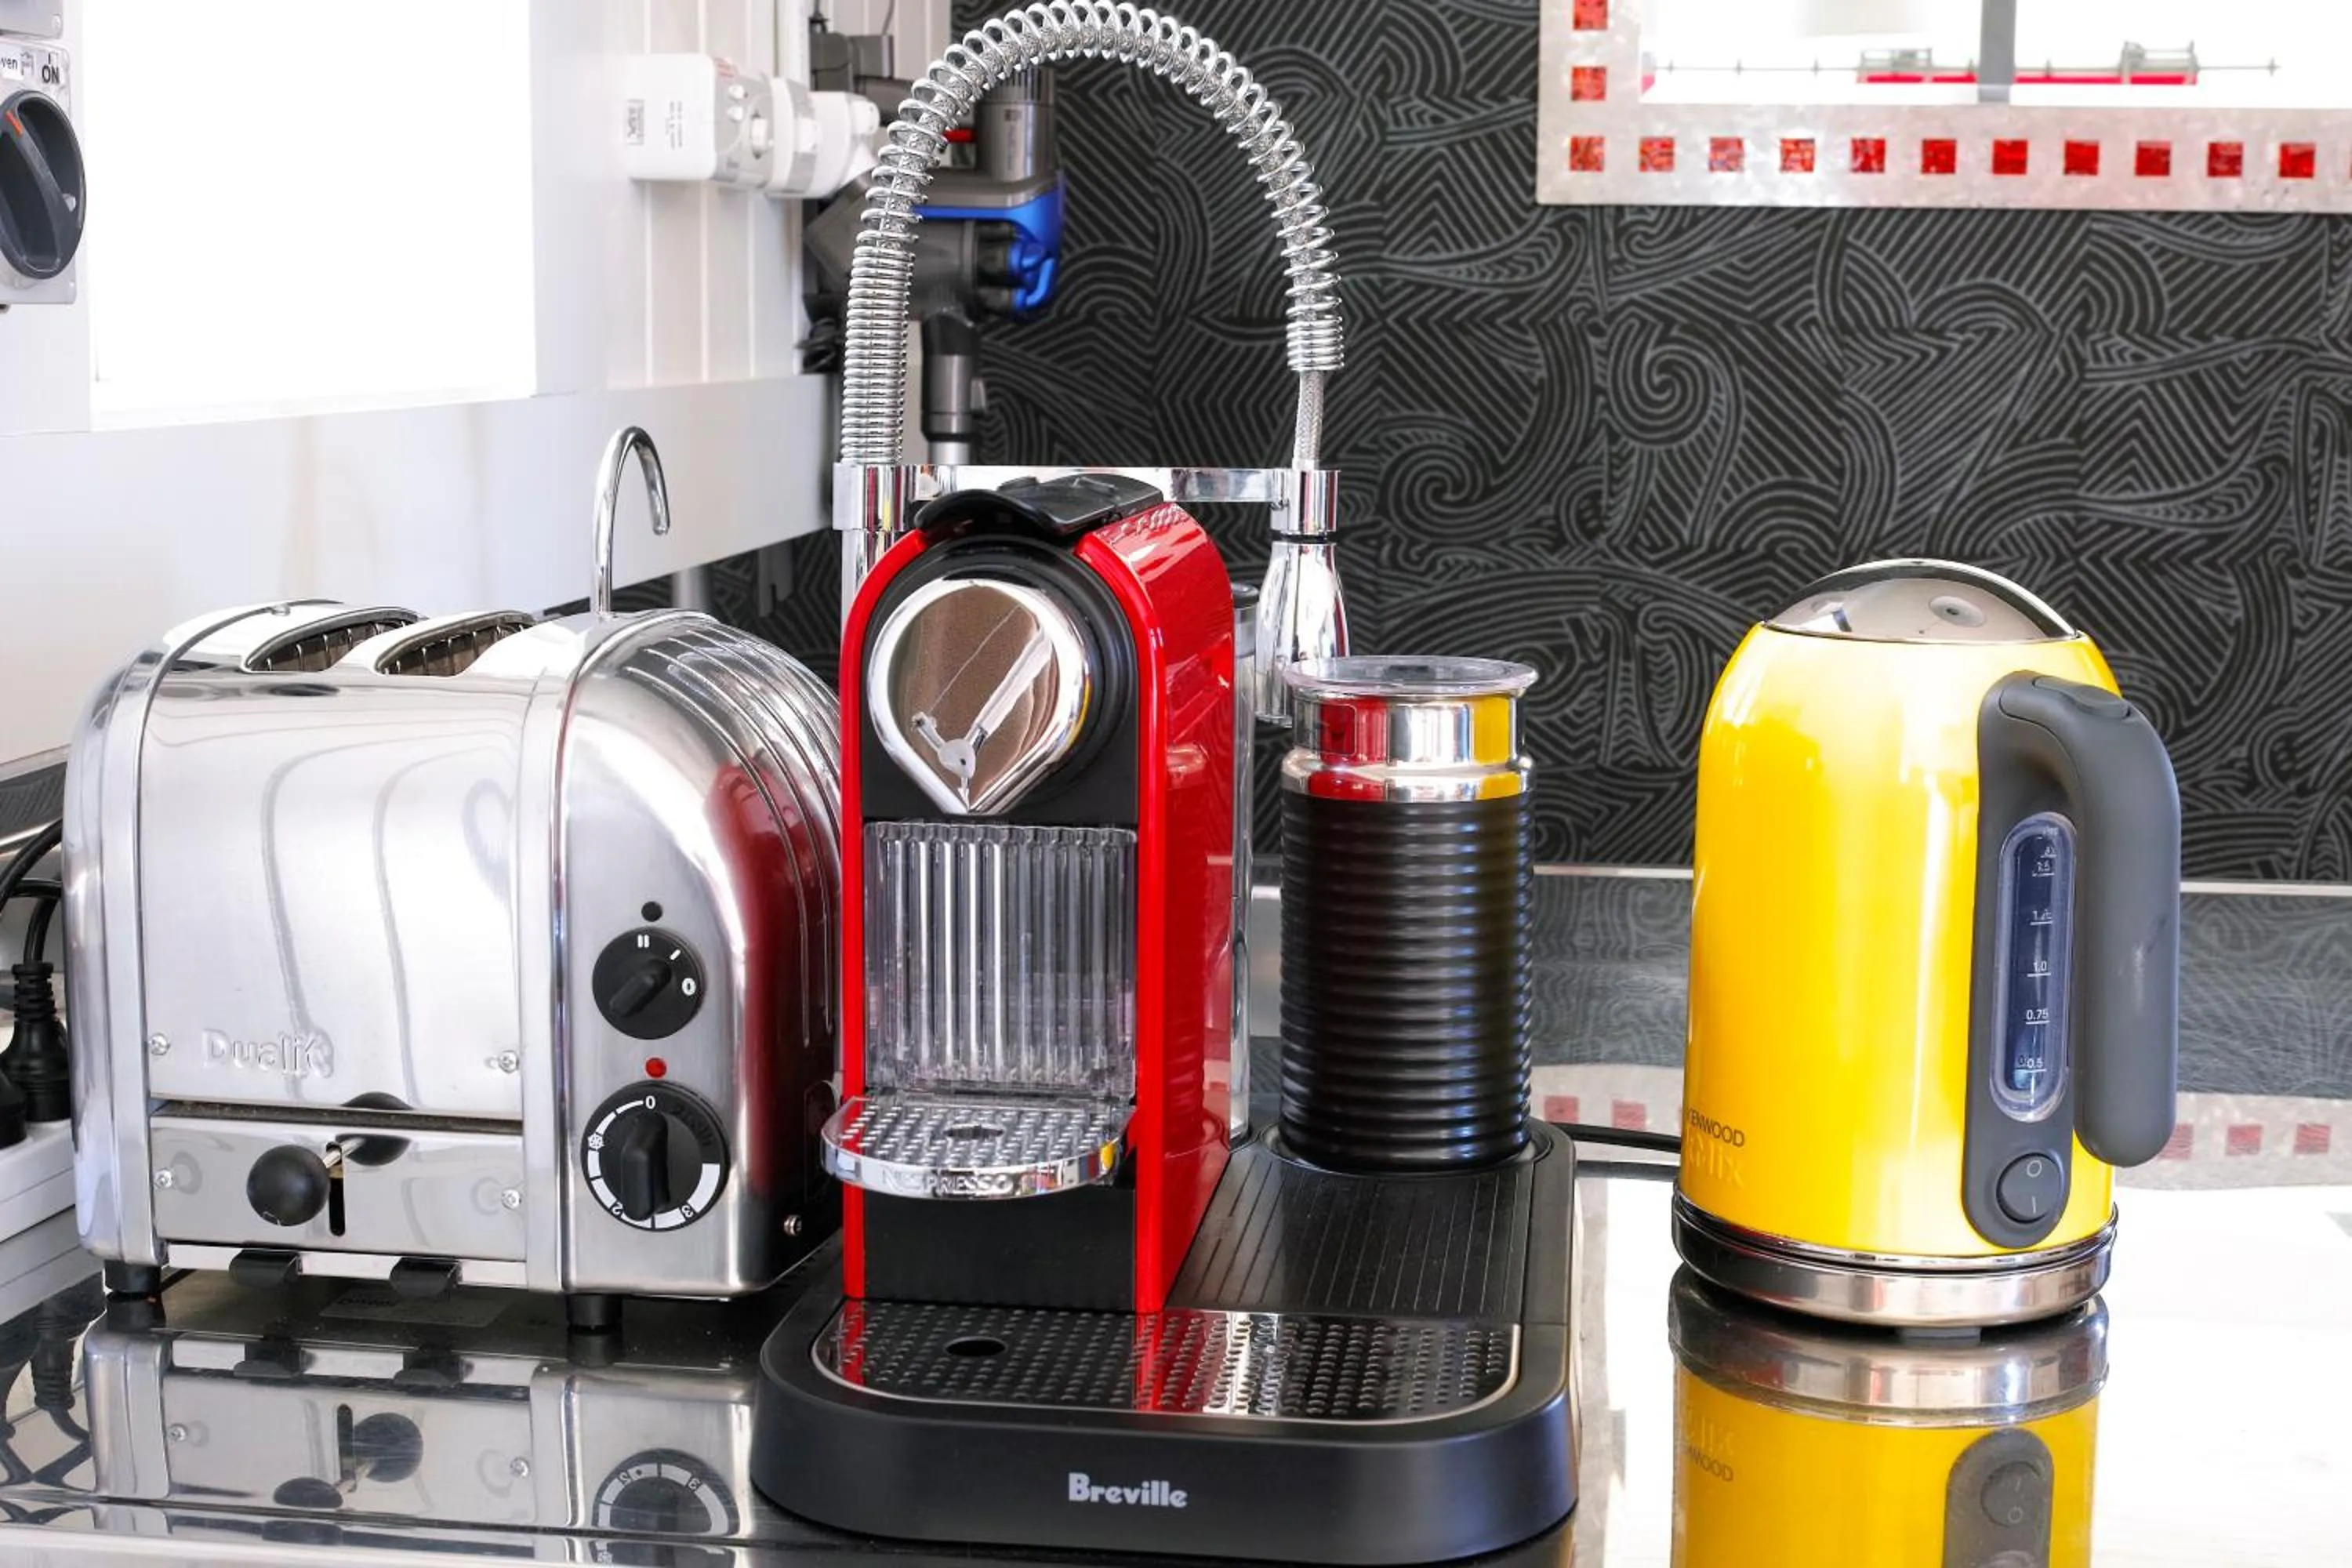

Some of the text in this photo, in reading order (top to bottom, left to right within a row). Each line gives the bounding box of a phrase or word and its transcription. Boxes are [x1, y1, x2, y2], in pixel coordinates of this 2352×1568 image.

[42, 64, 60, 84] ON
[2033, 960, 2048, 973] 1.0
[2025, 1008, 2050, 1022] 0.75
[2026, 1058, 2044, 1069] 0.5
[1068, 1472, 1188, 1508] Breville
